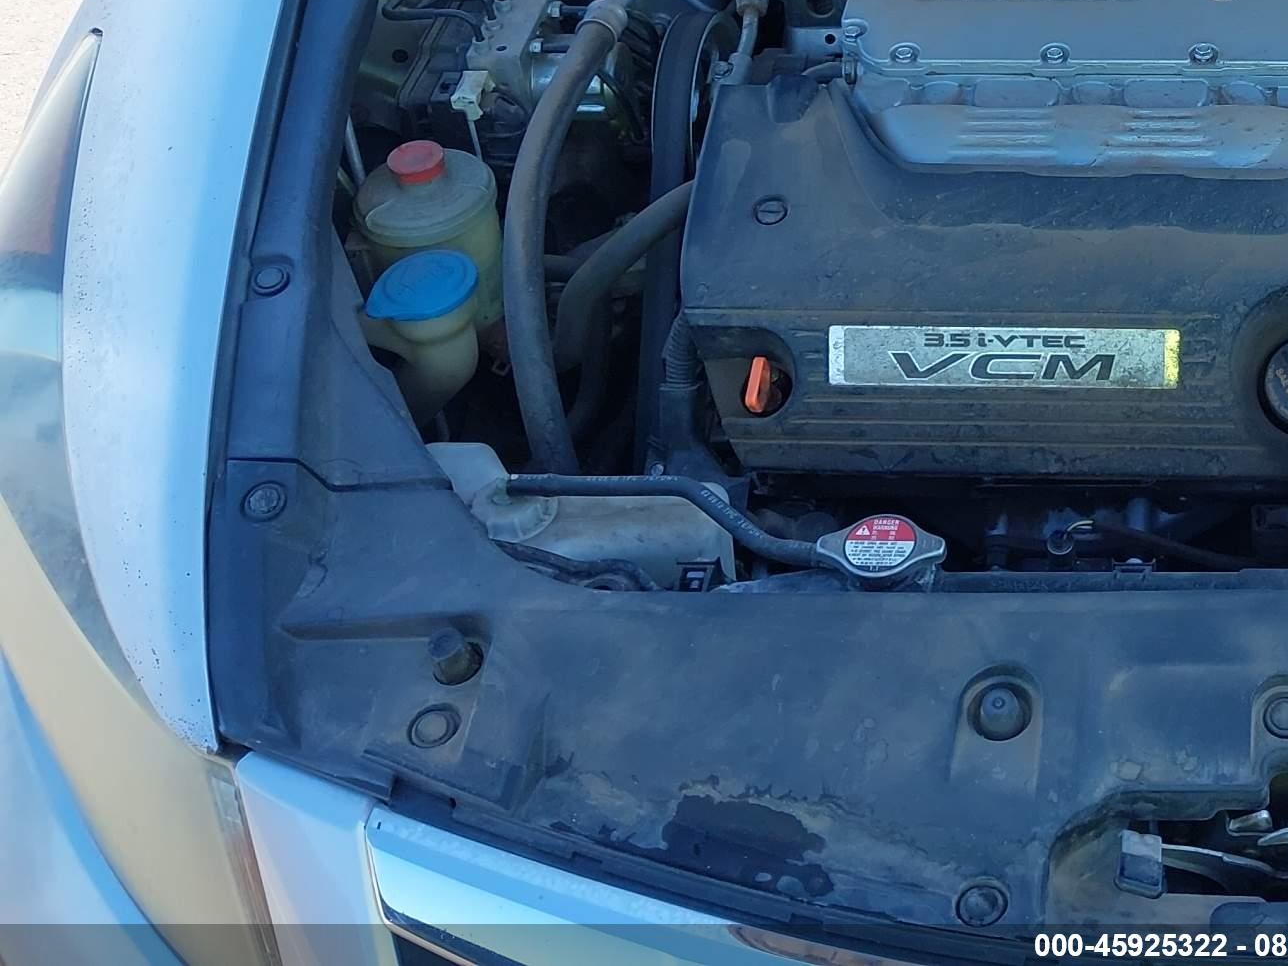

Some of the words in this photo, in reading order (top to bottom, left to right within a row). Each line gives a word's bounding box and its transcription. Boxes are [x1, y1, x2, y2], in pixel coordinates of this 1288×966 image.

[923, 332, 970, 348] 3.5
[977, 333, 1086, 349] i-VTEC
[888, 351, 1116, 381] VCM
